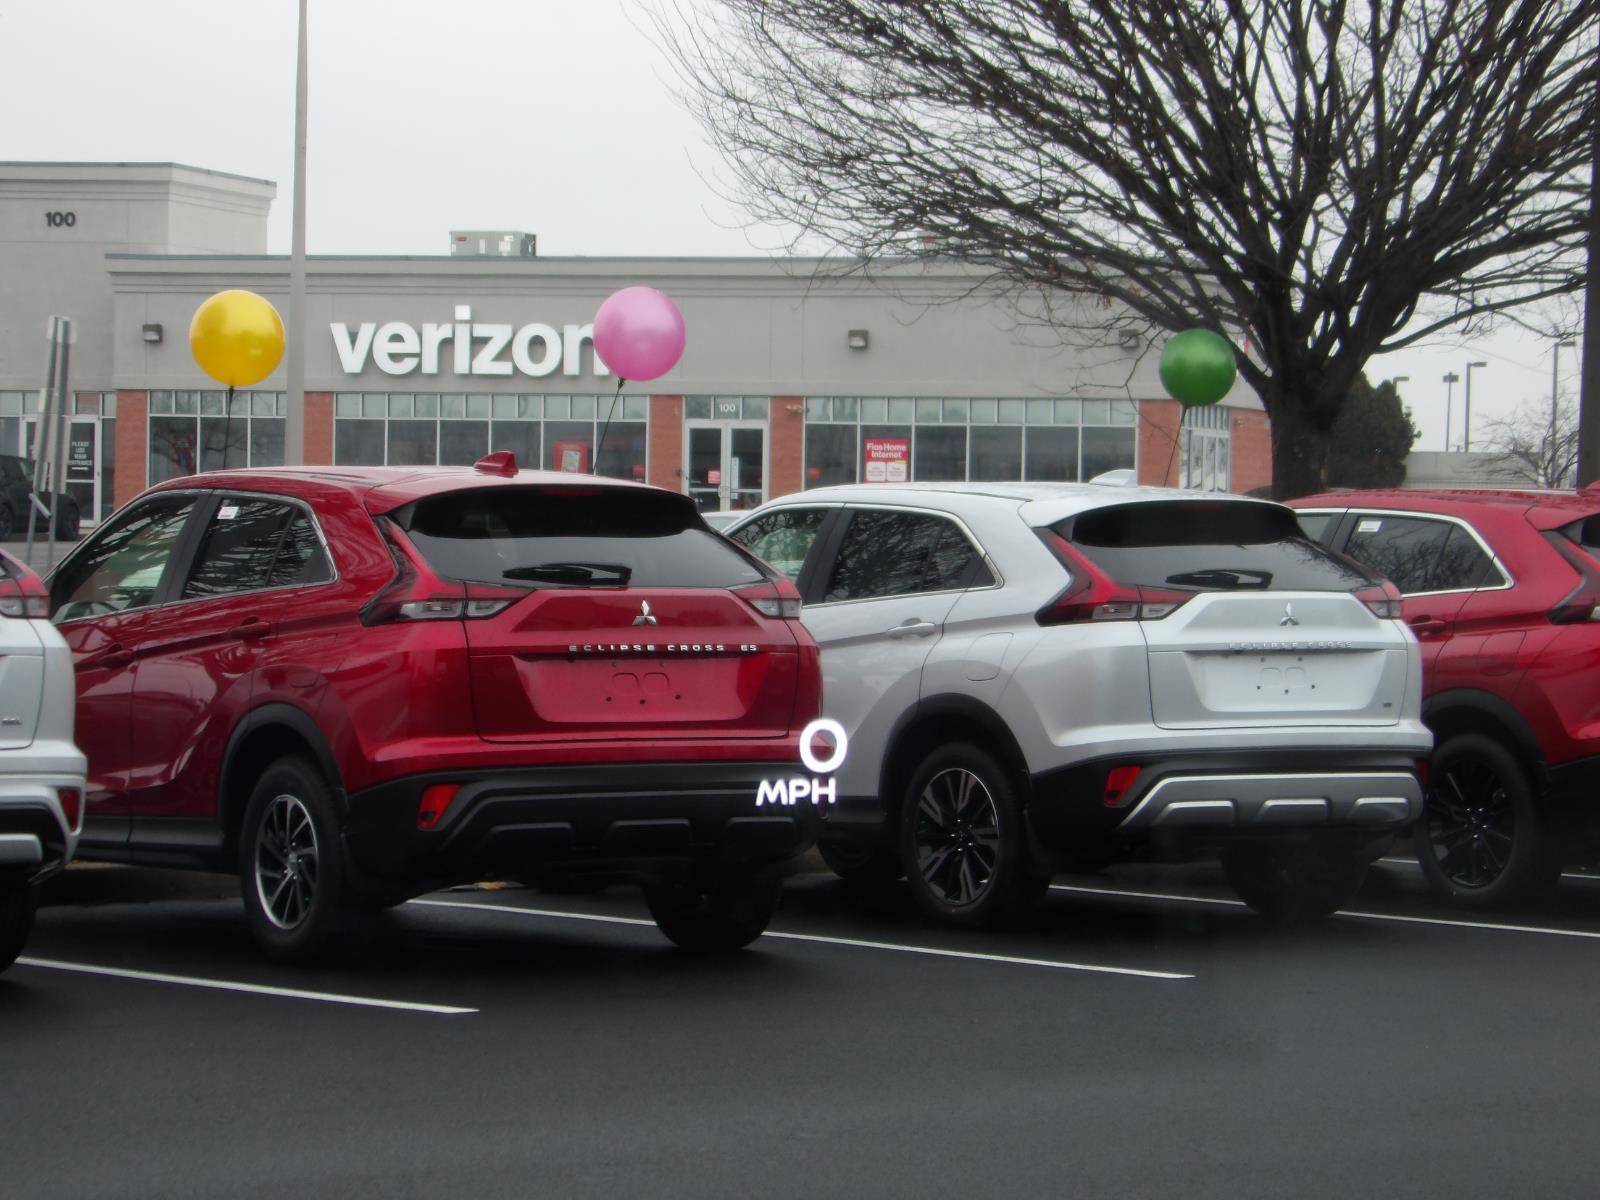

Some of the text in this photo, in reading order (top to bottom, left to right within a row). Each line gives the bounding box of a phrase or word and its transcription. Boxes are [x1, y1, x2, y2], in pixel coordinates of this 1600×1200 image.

[45, 211, 76, 227] 100
[330, 305, 611, 376] verizon
[720, 403, 736, 412] 100
[871, 450, 902, 458] Internet
[800, 719, 847, 773] 0
[756, 778, 836, 806] MPH
